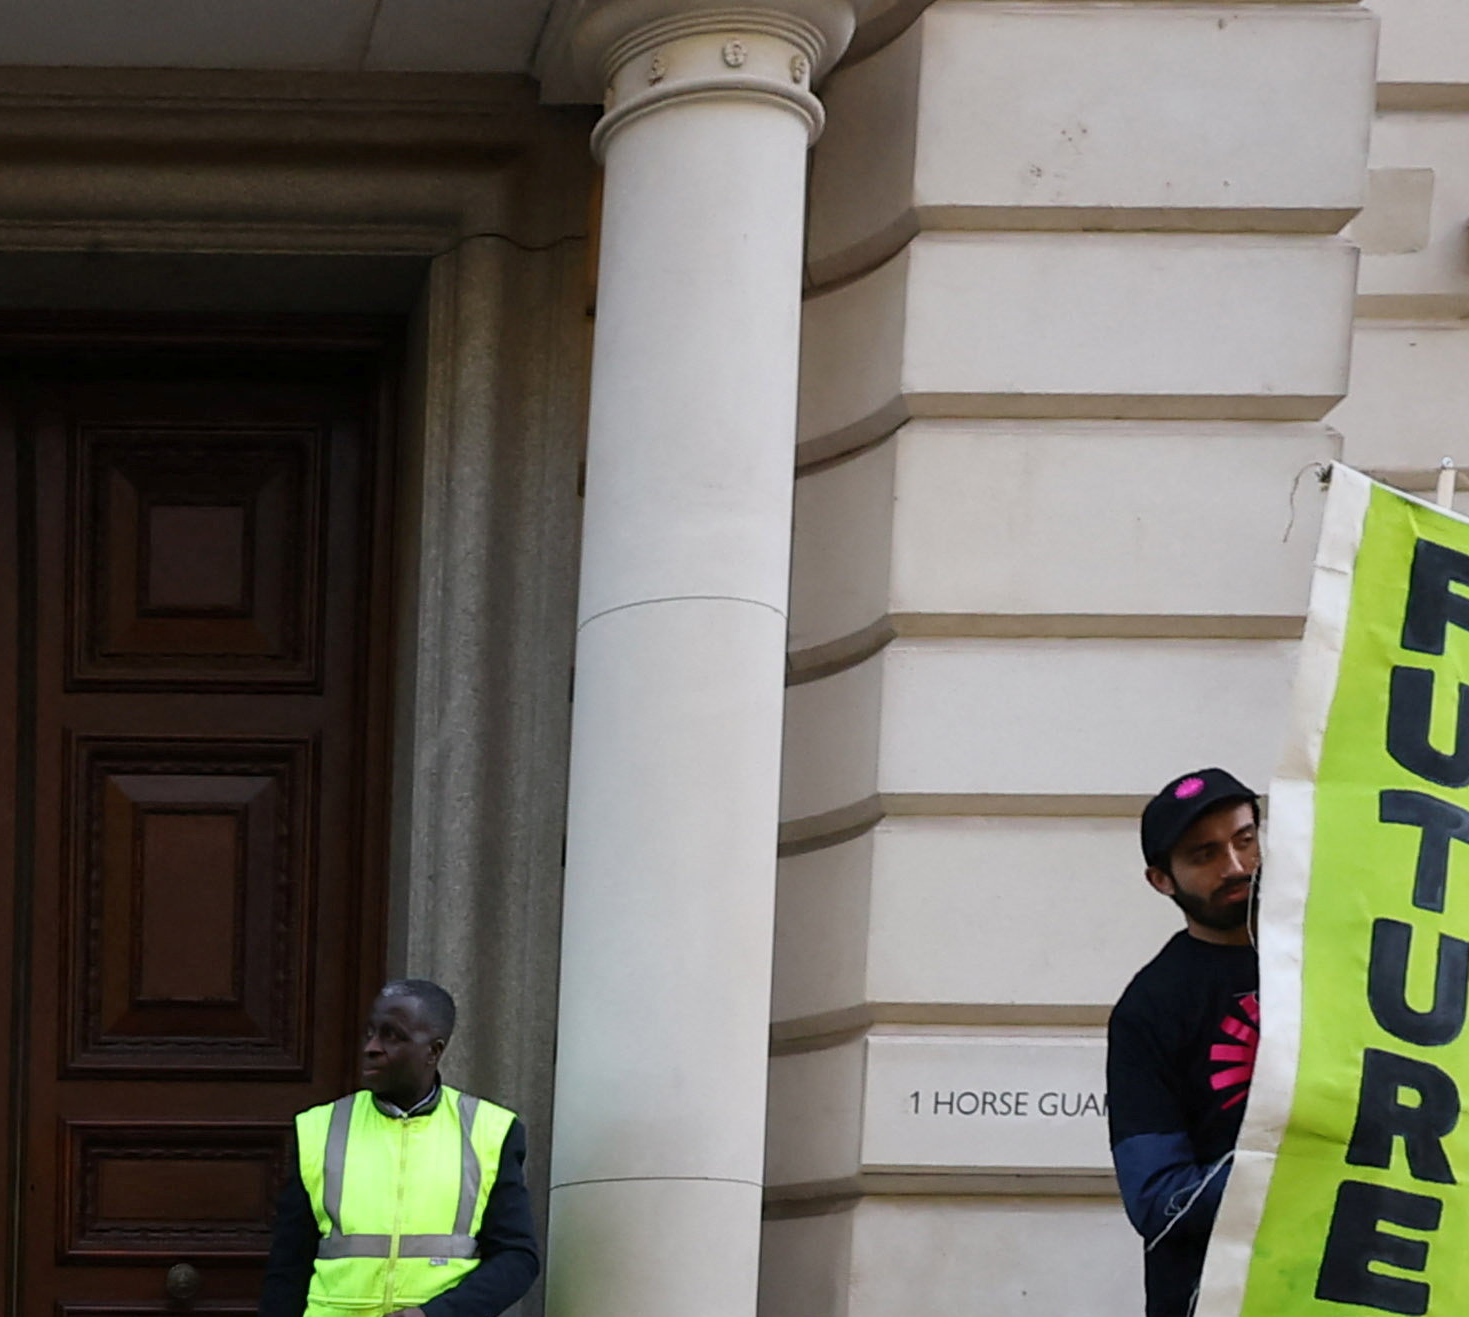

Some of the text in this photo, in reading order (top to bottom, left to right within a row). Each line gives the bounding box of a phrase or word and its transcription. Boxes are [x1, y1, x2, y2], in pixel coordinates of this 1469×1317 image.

[909, 1091, 1109, 1117] 1 HORSE GUA
